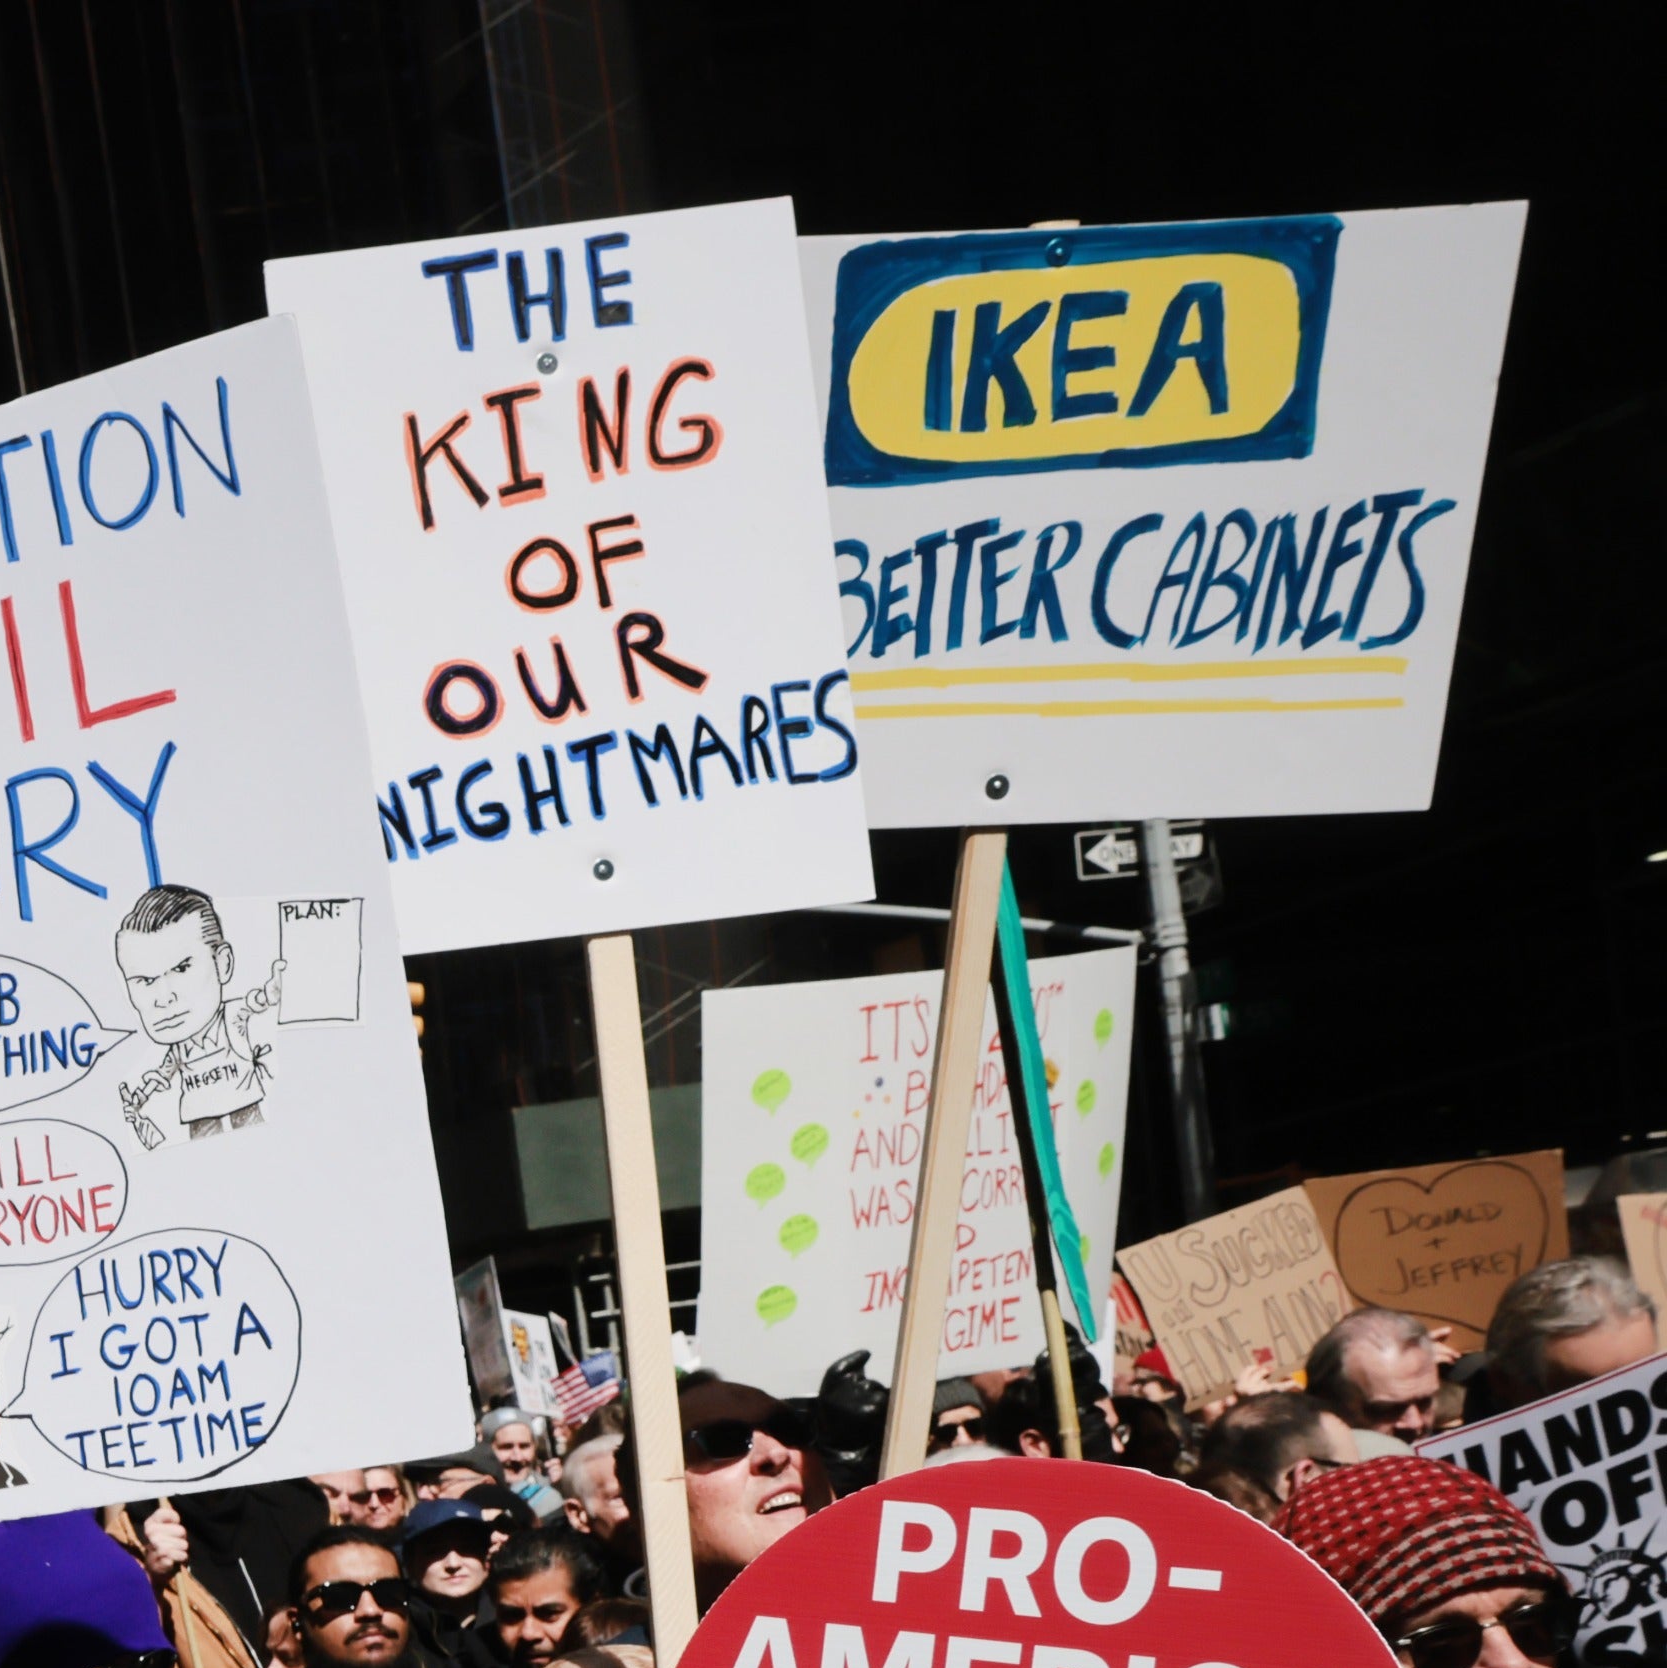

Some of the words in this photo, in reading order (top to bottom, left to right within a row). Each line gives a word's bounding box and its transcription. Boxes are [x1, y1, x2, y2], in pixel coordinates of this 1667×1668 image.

[422, 232, 635, 352] THE
[923, 282, 1228, 433] IKEA
[402, 357, 724, 532] KING
[504, 513, 644, 614] OF
[834, 517, 1083, 660] BETTER
[1091, 487, 1458, 656] CABINETS
[422, 610, 710, 739] OUR
[376, 669, 858, 861] NIGHTMARES
[283, 902, 342, 922] PLAN:
[185, 1063, 238, 1091] HEGSETH
[851, 1121, 921, 1173] AND
[850, 1180, 914, 1230] WAS
[963, 1168, 1026, 1213] CORR
[75, 1239, 232, 1321] HURRY
[1378, 1243, 1524, 1296] JEFFREY
[49, 1331, 82, 1379] I
[99, 1312, 210, 1372] GOT
[232, 1303, 272, 1356] A
[944, 1296, 1021, 1353] GIME
[1540, 1450, 1667, 1546] OF
[872, 1499, 1224, 1626] PRO-
